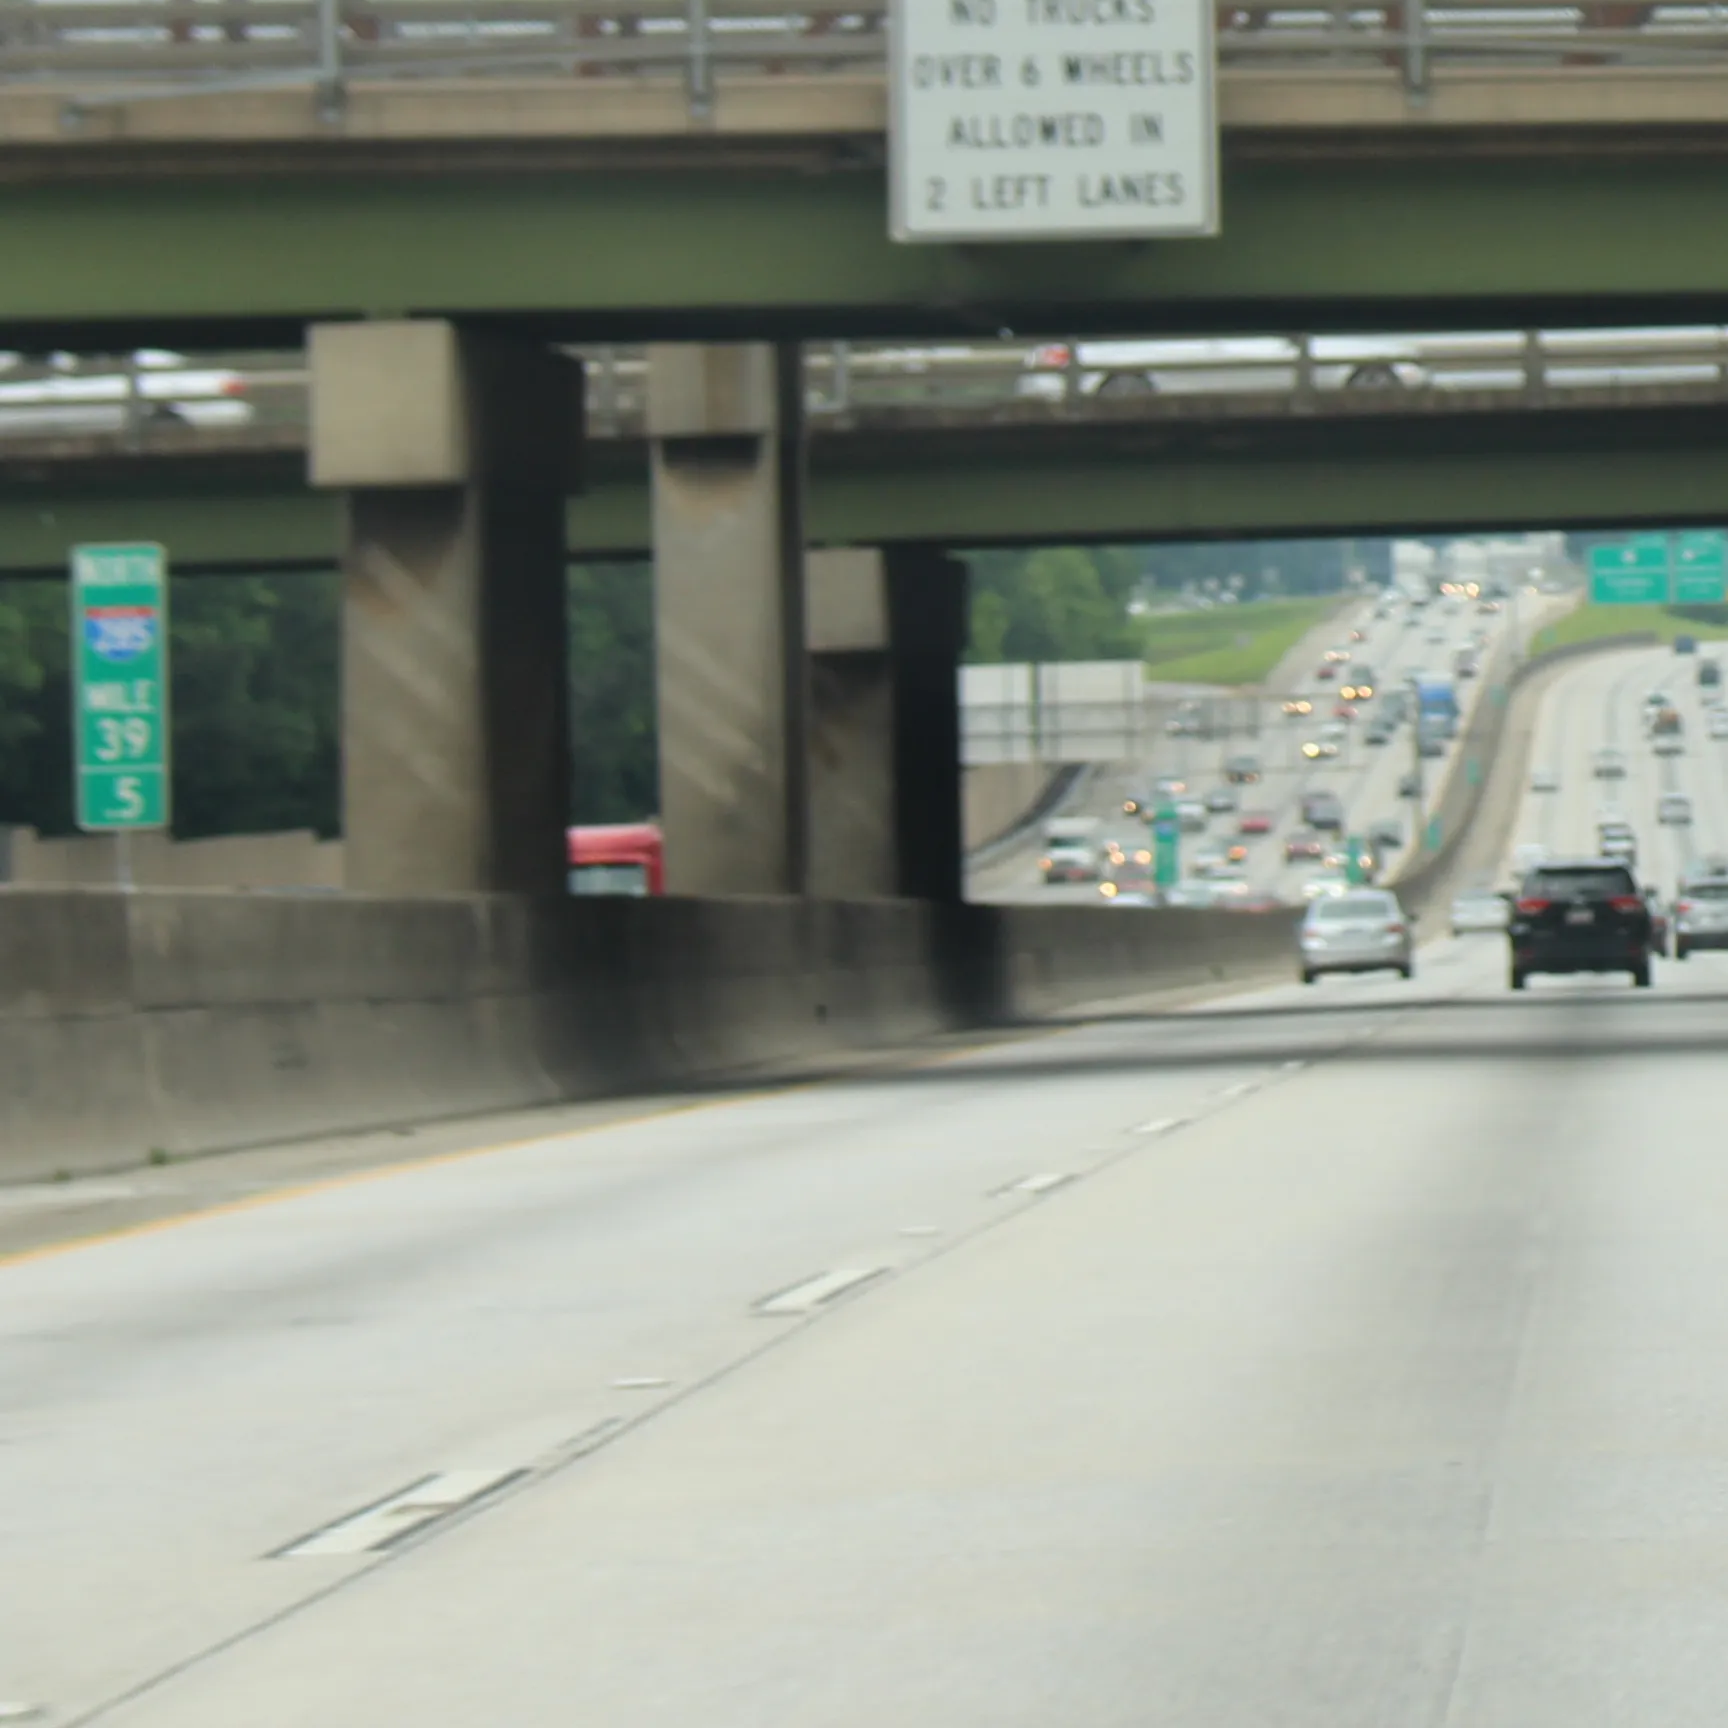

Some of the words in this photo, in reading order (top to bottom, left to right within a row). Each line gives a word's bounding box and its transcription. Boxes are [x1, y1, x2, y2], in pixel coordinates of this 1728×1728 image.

[914, 55, 1003, 89] OVER
[1019, 55, 1042, 86] 6
[1062, 51, 1195, 87] WHEELS
[946, 113, 1105, 149] ALLOWED
[1128, 112, 1165, 145] IN
[926, 178, 947, 211] 2
[971, 175, 1051, 210] LEFT
[1078, 172, 1187, 209] LANES
[86, 680, 154, 712] MILE
[95, 717, 151, 761] 39
